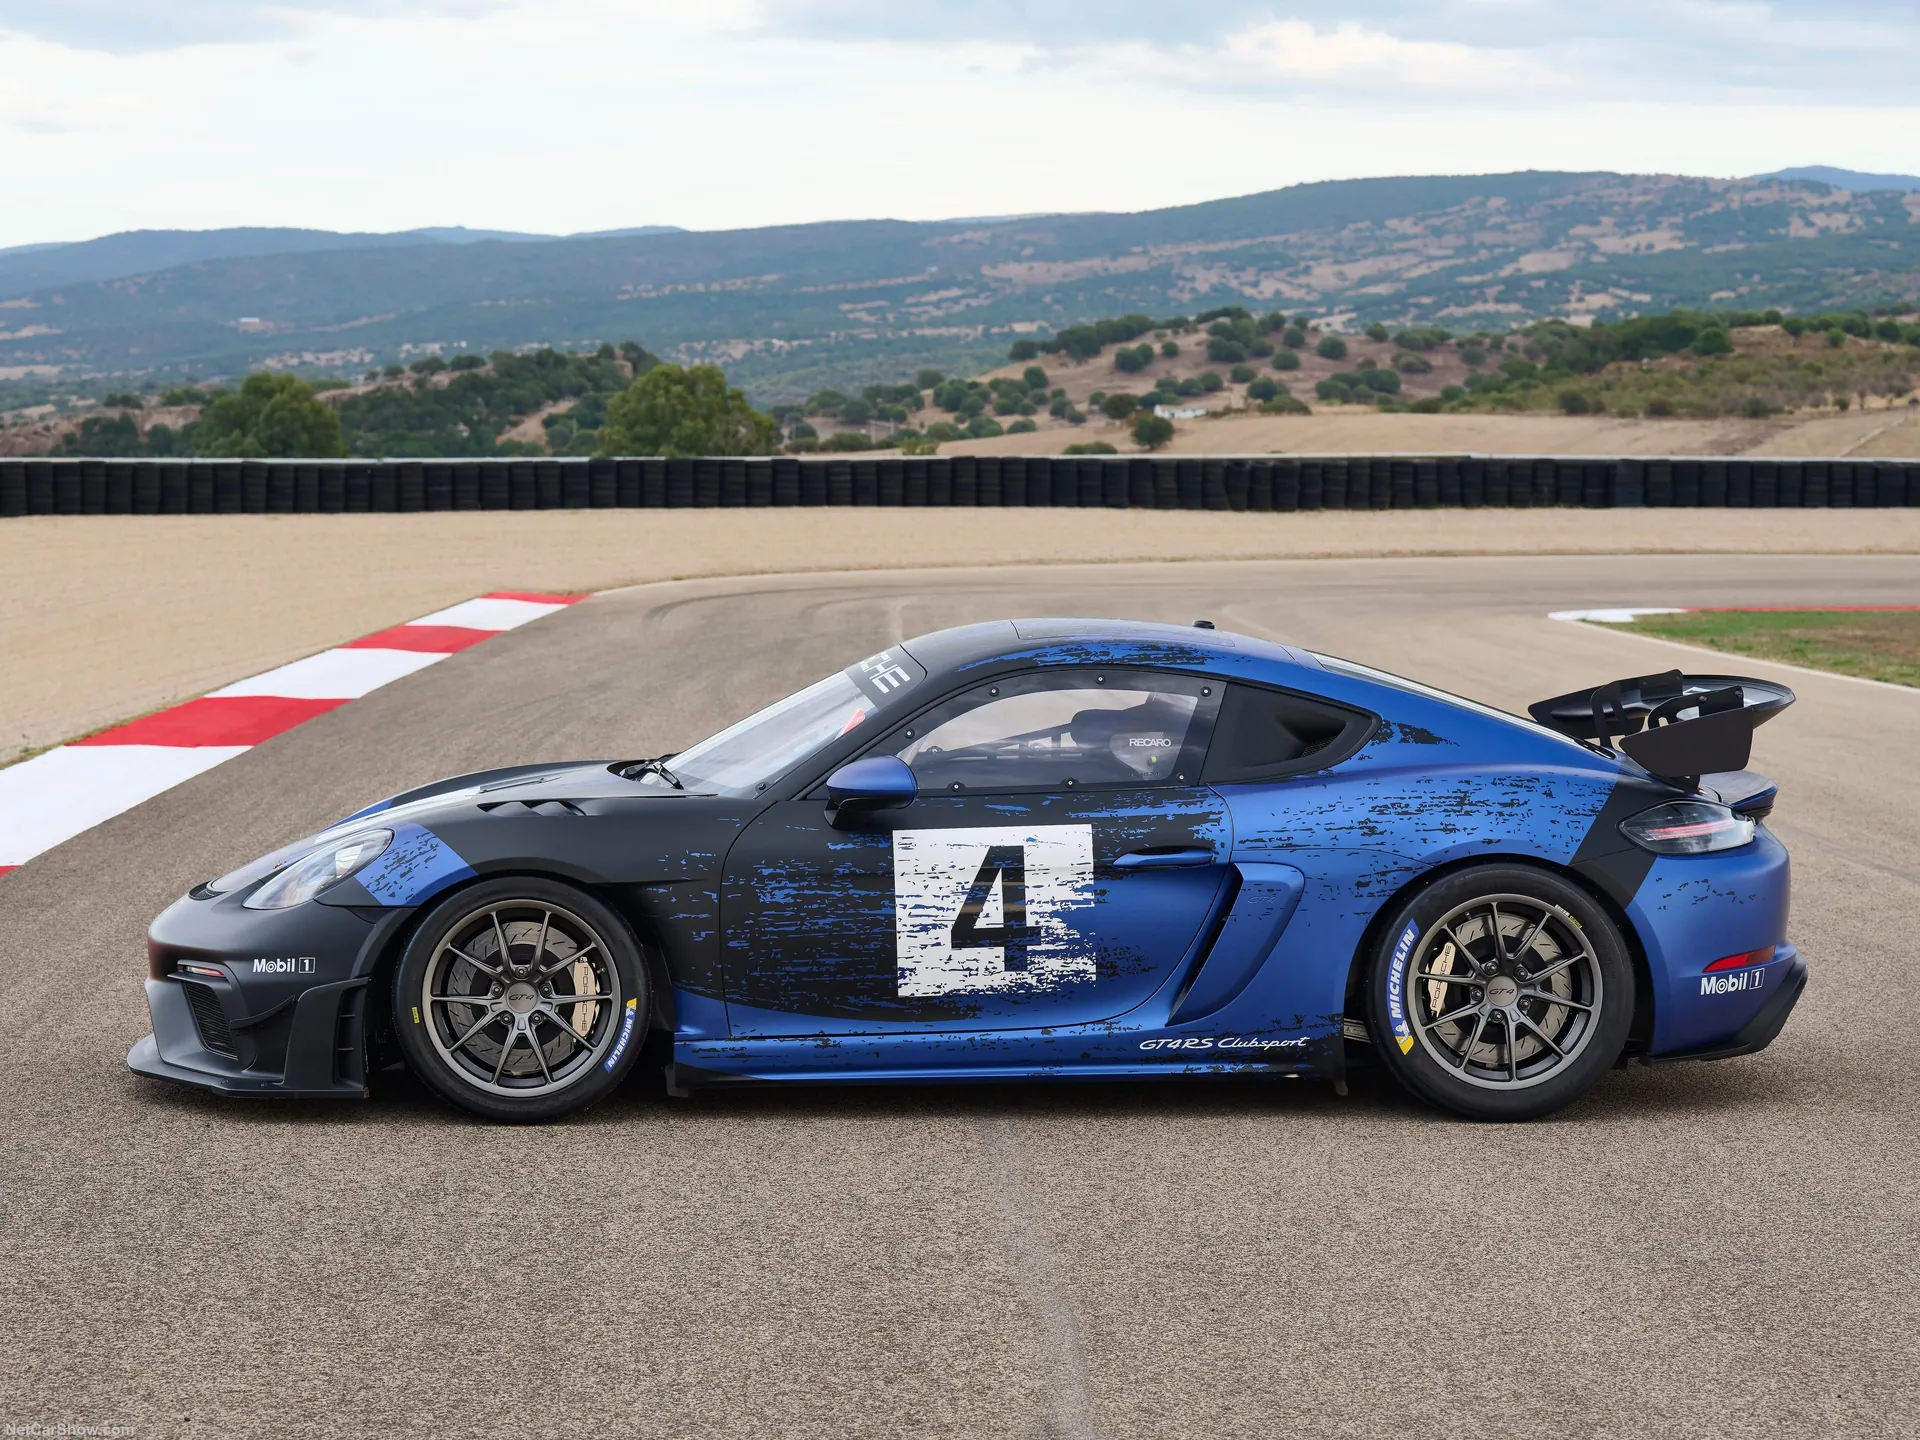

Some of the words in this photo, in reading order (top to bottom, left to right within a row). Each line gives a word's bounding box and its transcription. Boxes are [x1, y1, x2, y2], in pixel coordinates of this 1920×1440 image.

[1129, 738, 1171, 747] RECARO
[951, 845, 1042, 972] 4
[252, 958, 296, 974] Mobil
[1389, 928, 1415, 1019] MICHELIN
[1431, 945, 1452, 1009] PORCHE
[1700, 972, 1748, 996] Mobil
[607, 1018, 633, 1068] MICHELIN
[1217, 1037, 1310, 1051] Clubsport
